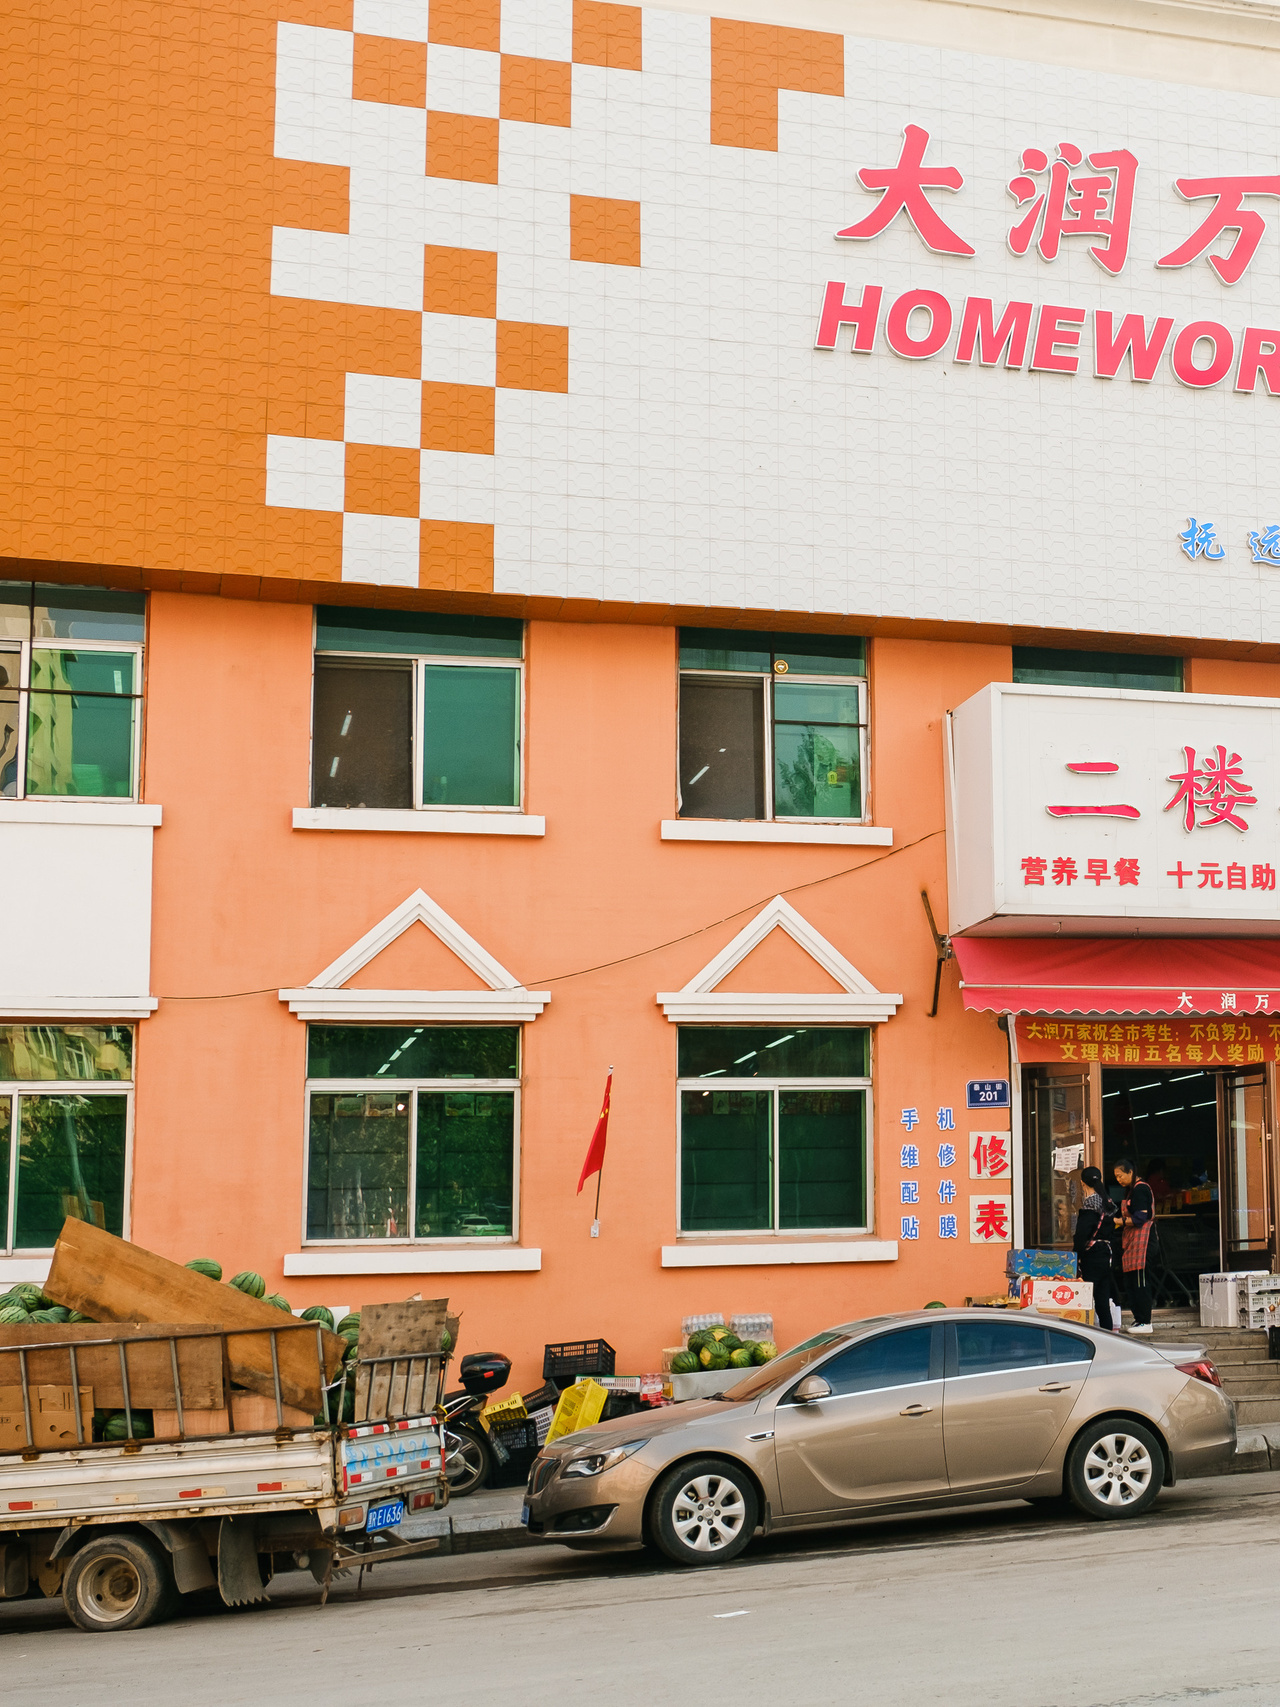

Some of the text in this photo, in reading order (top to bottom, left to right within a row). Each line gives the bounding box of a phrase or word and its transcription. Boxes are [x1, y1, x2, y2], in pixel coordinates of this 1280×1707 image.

[1020, 856, 1142, 887] 营养早餐
[979, 1091, 998, 1101] 201
